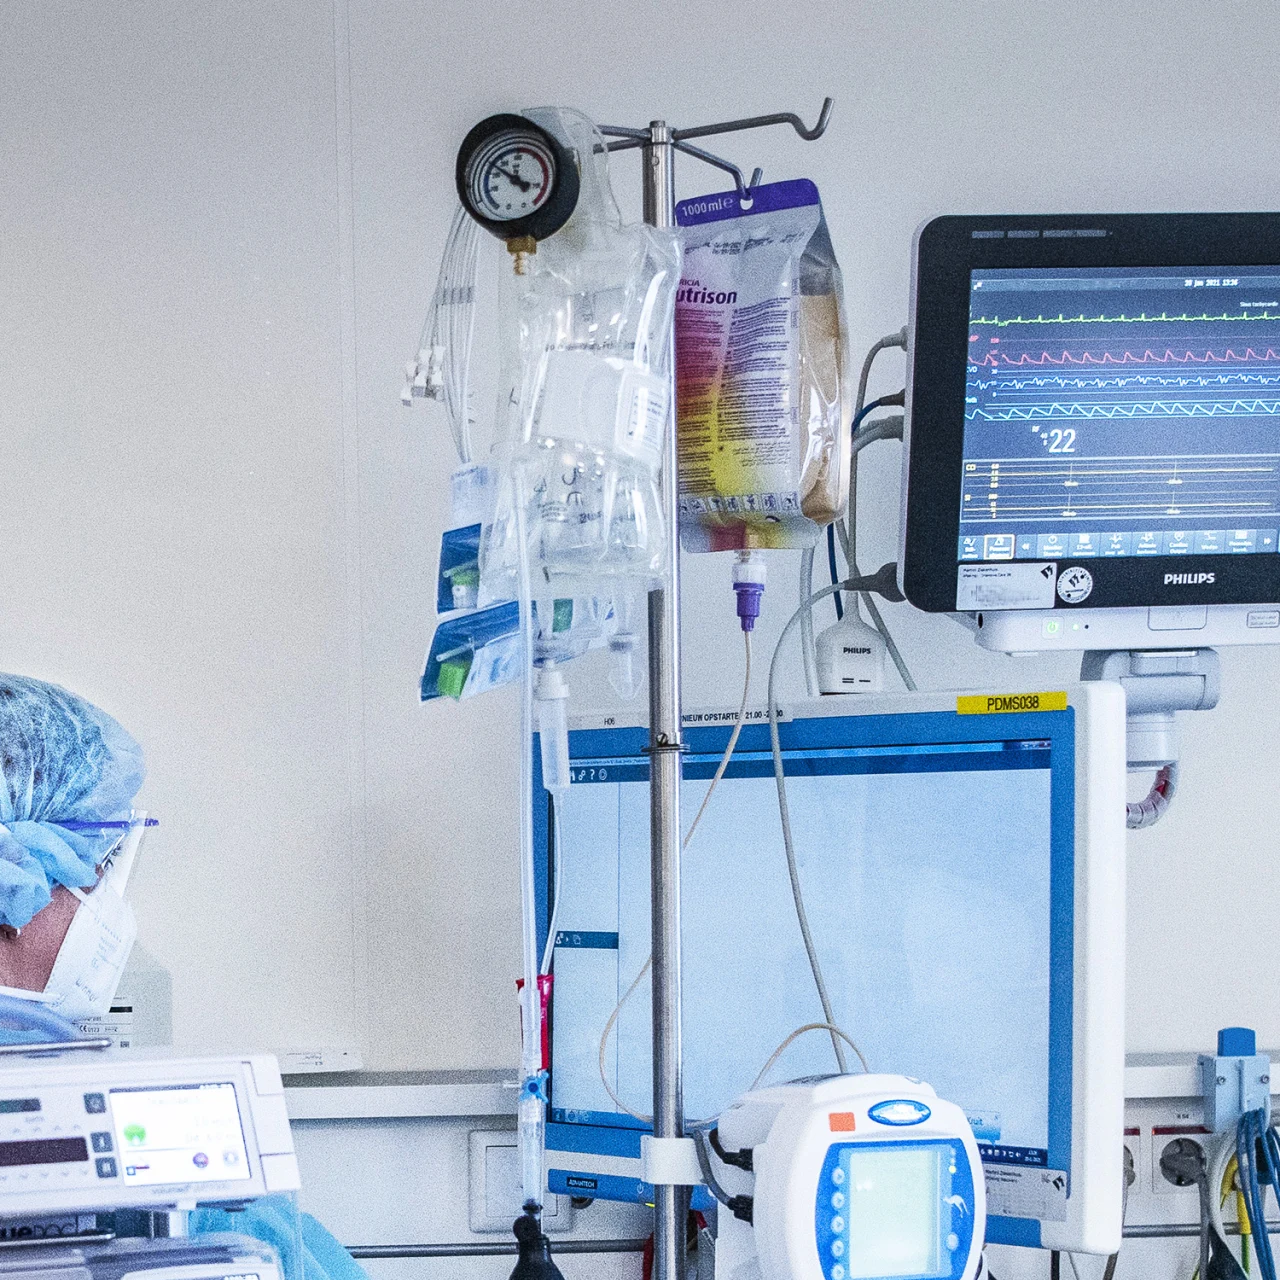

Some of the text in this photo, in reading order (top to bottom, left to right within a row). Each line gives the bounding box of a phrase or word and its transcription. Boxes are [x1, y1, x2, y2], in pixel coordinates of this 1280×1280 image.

[682, 202, 707, 217] 1000
[676, 287, 738, 305] utrison
[1048, 428, 1076, 453] 22
[1163, 572, 1216, 585] PHILIPS
[842, 646, 872, 656] PHILIPS
[987, 695, 1040, 711] PDMS038
[703, 713, 740, 722] OPSTARTE
[745, 711, 763, 720] 21.00
[567, 1178, 596, 1189] ADVANTECH
